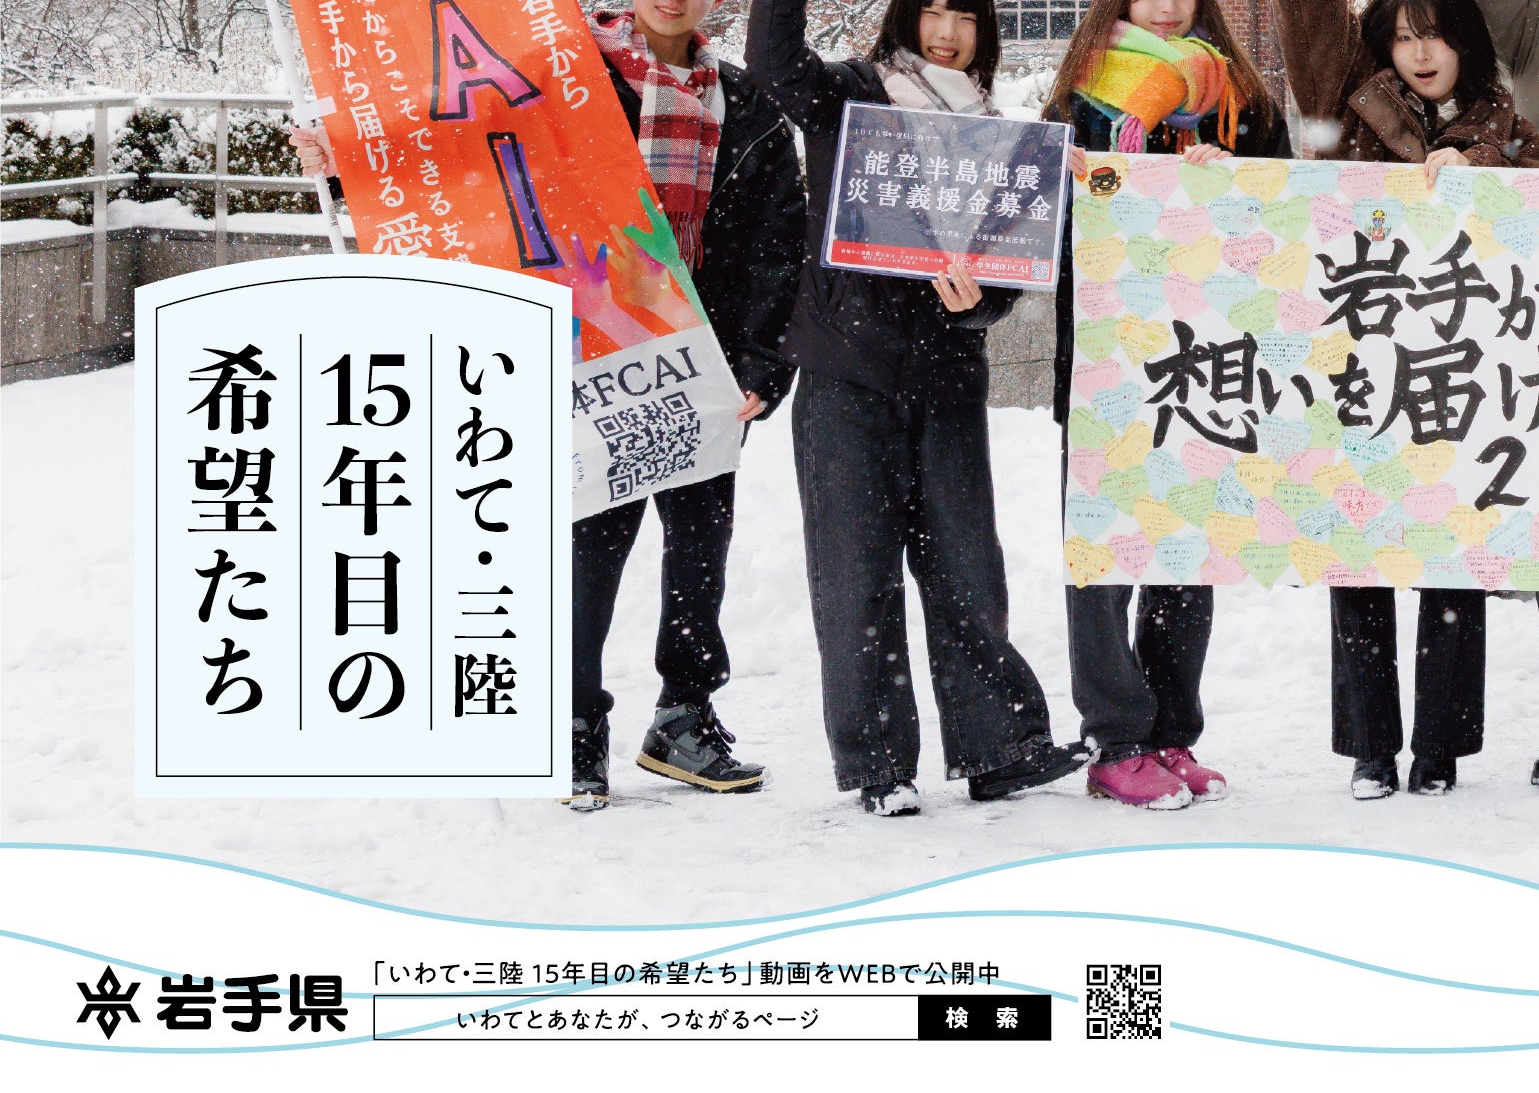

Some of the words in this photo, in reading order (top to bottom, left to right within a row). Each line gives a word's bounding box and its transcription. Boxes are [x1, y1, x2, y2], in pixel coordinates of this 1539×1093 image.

[865, 150, 1041, 190] 能登半島地震
[844, 178, 1051, 221] 災害義援金募金
